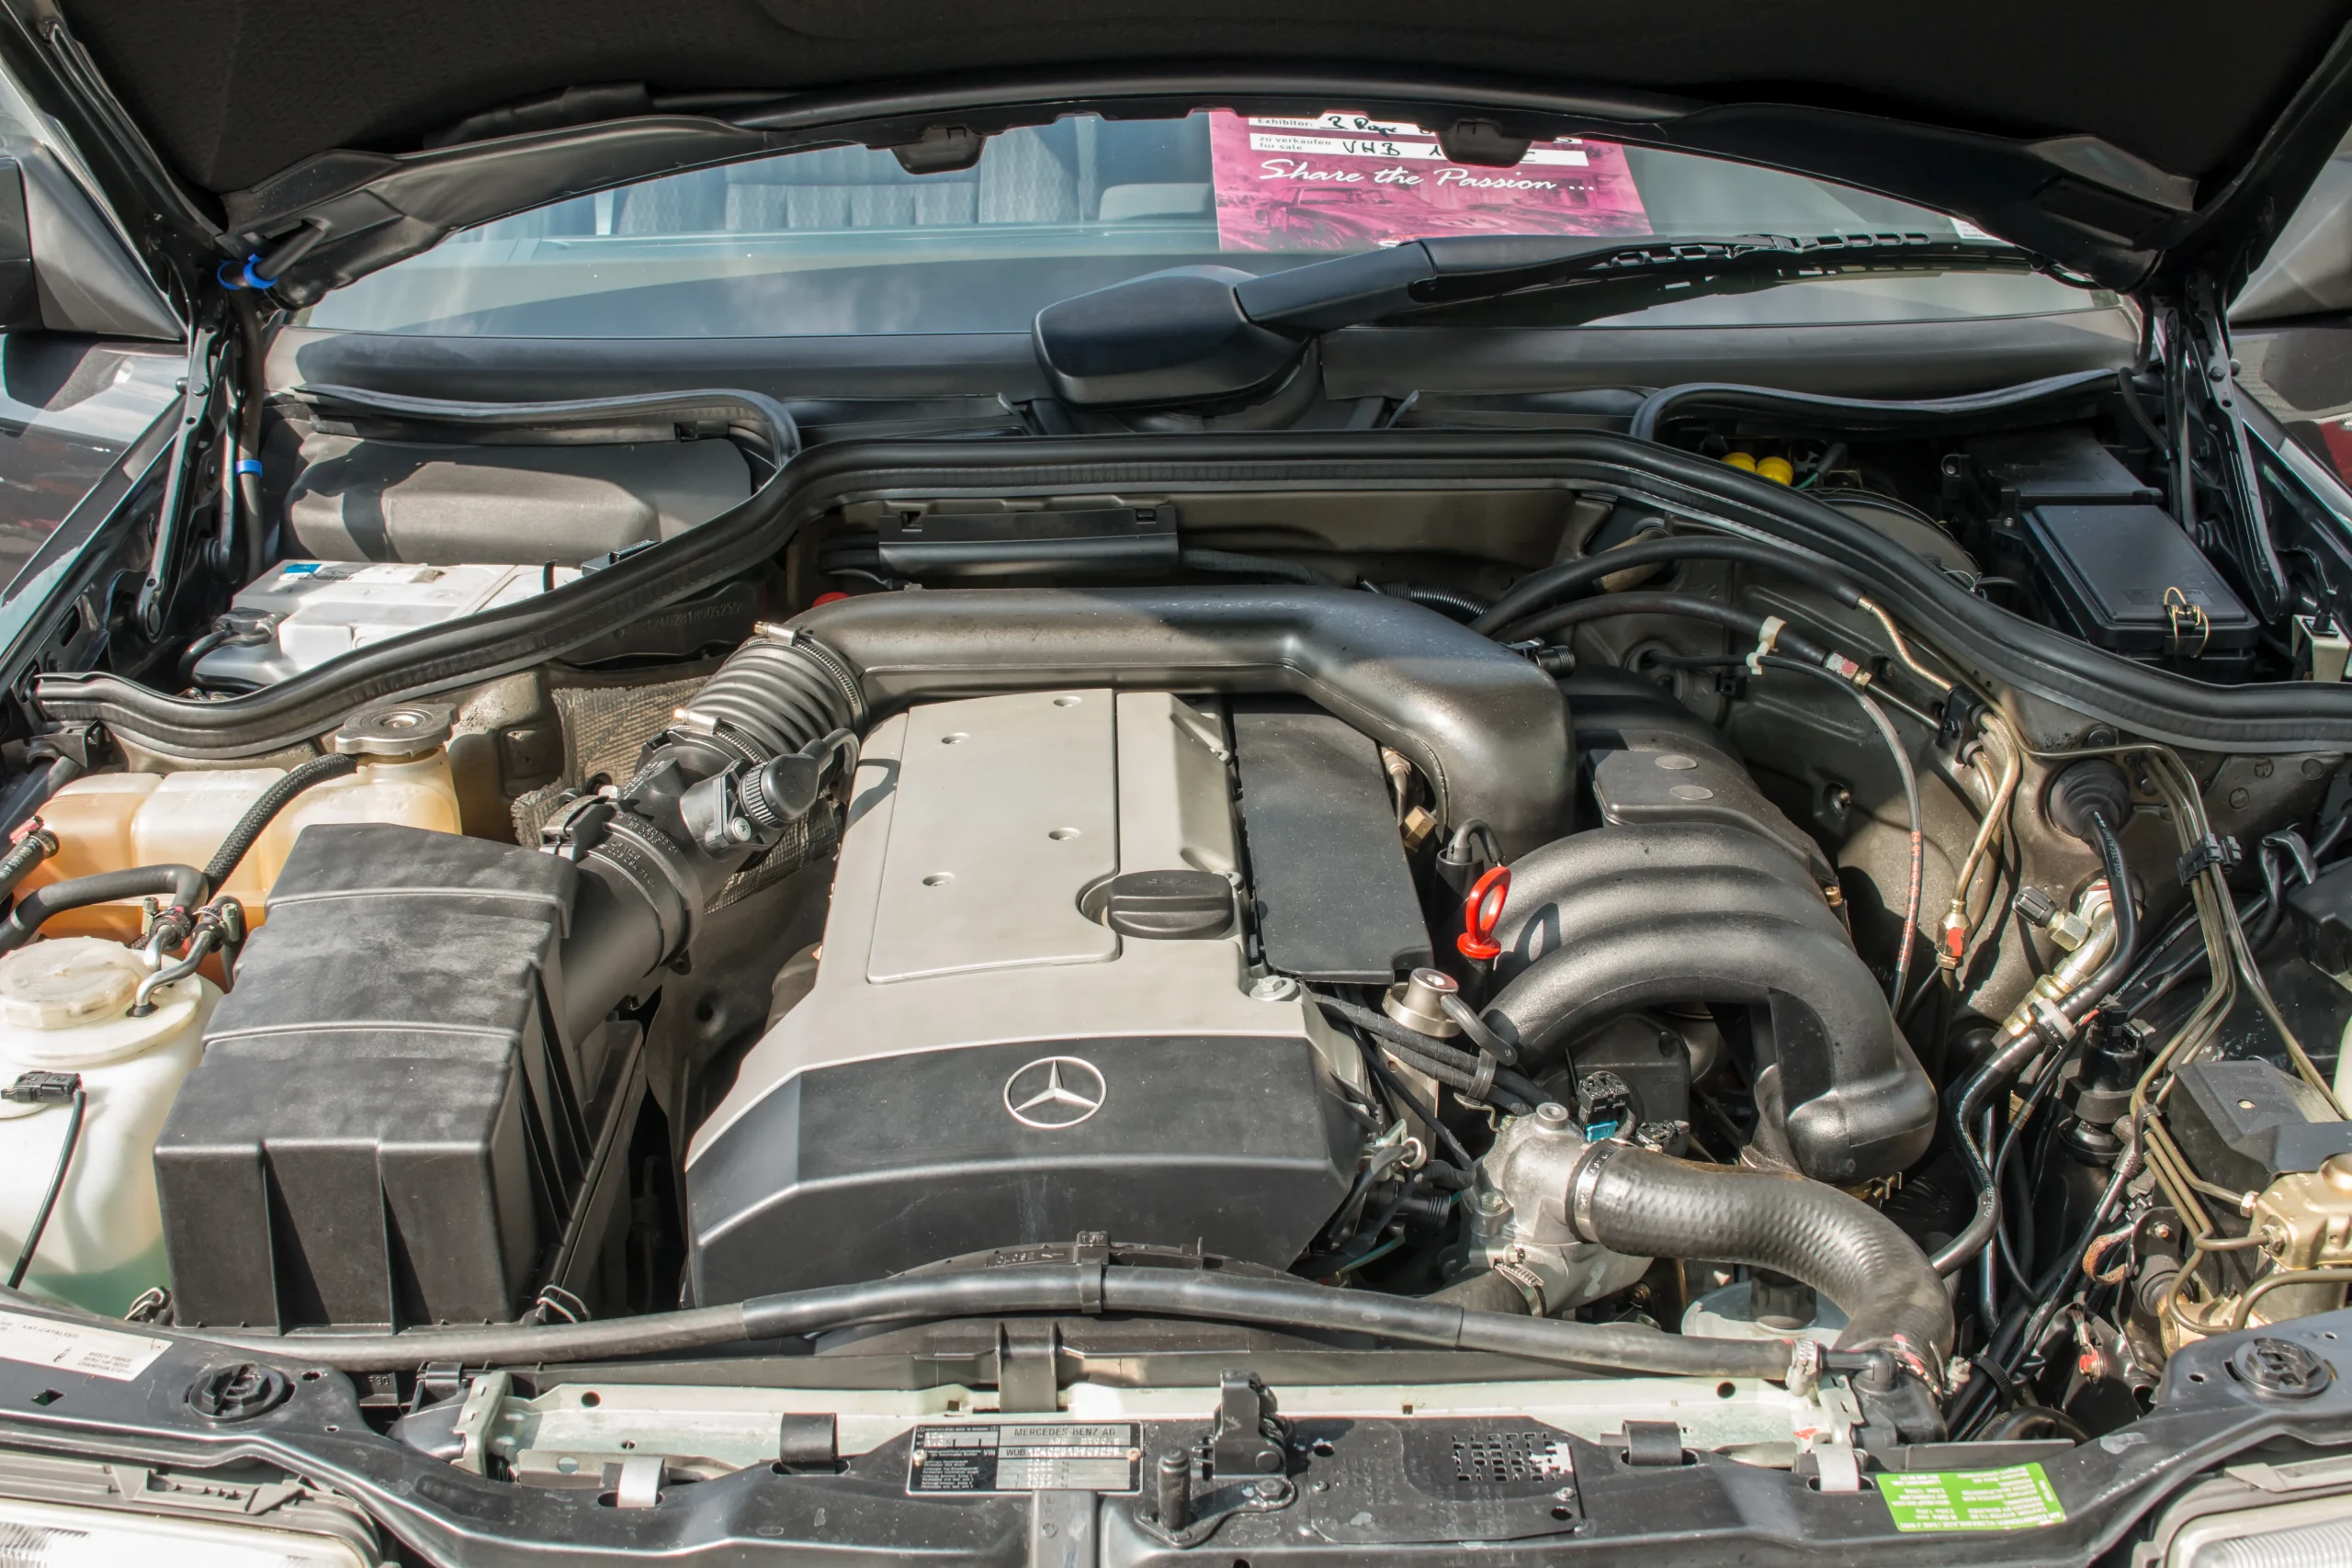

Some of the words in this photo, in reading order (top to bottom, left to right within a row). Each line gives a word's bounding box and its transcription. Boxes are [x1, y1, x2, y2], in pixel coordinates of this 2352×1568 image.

[1275, 137, 1331, 146] verkaufen
[1259, 158, 1364, 183] Share
[1374, 166, 1424, 185] the
[1433, 168, 1556, 190] Passion
[1005, 1448, 1025, 1456] WDB
